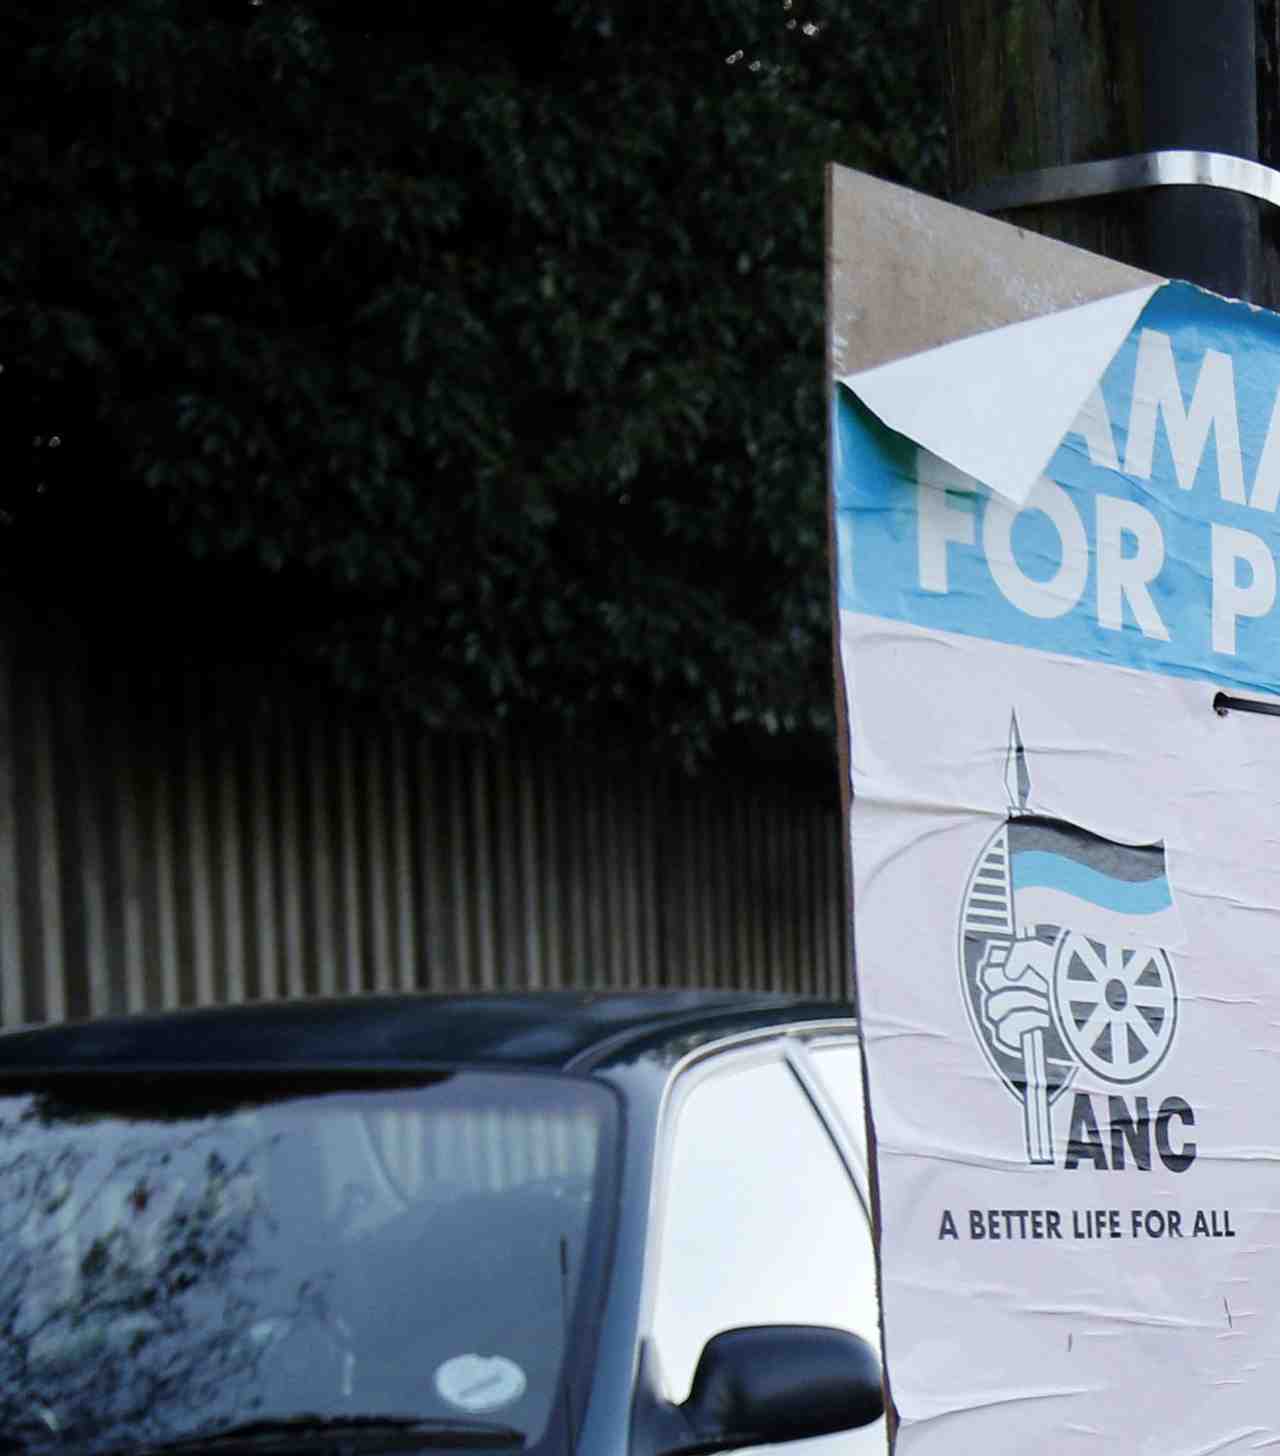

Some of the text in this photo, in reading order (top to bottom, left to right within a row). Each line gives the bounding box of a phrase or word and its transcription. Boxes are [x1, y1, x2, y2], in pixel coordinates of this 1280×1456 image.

[917, 449, 1170, 642] FOR
[1064, 1093, 1197, 1172] ANC
[938, 1210, 1236, 1240] A BETTER LIFE FOR ALL
